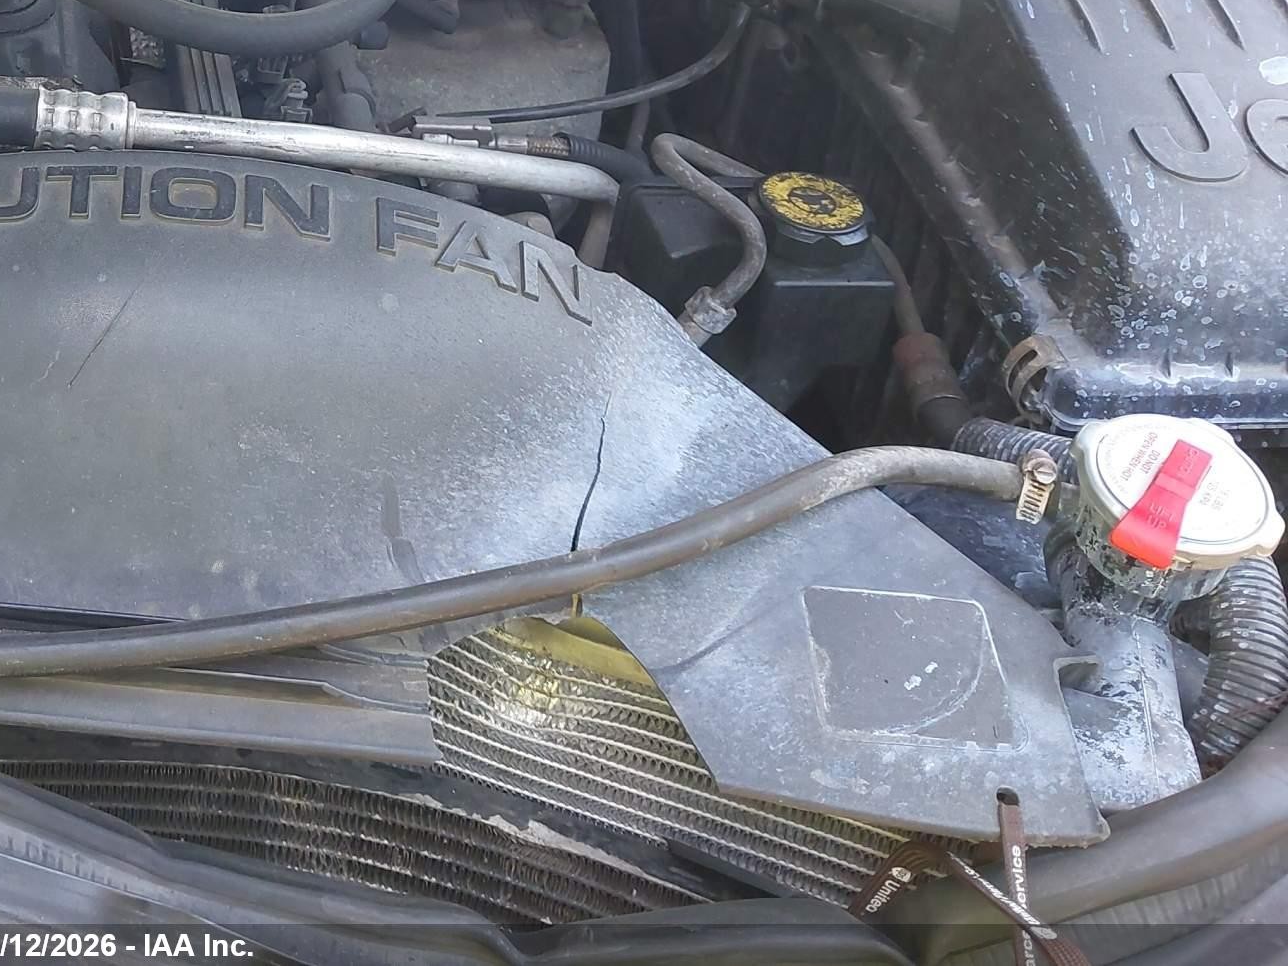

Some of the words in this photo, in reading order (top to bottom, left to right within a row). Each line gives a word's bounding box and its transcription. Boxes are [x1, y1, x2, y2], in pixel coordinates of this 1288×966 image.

[375, 195, 595, 326] FAN
[1146, 515, 1168, 530] UP
[1011, 844, 1028, 908] ervice
